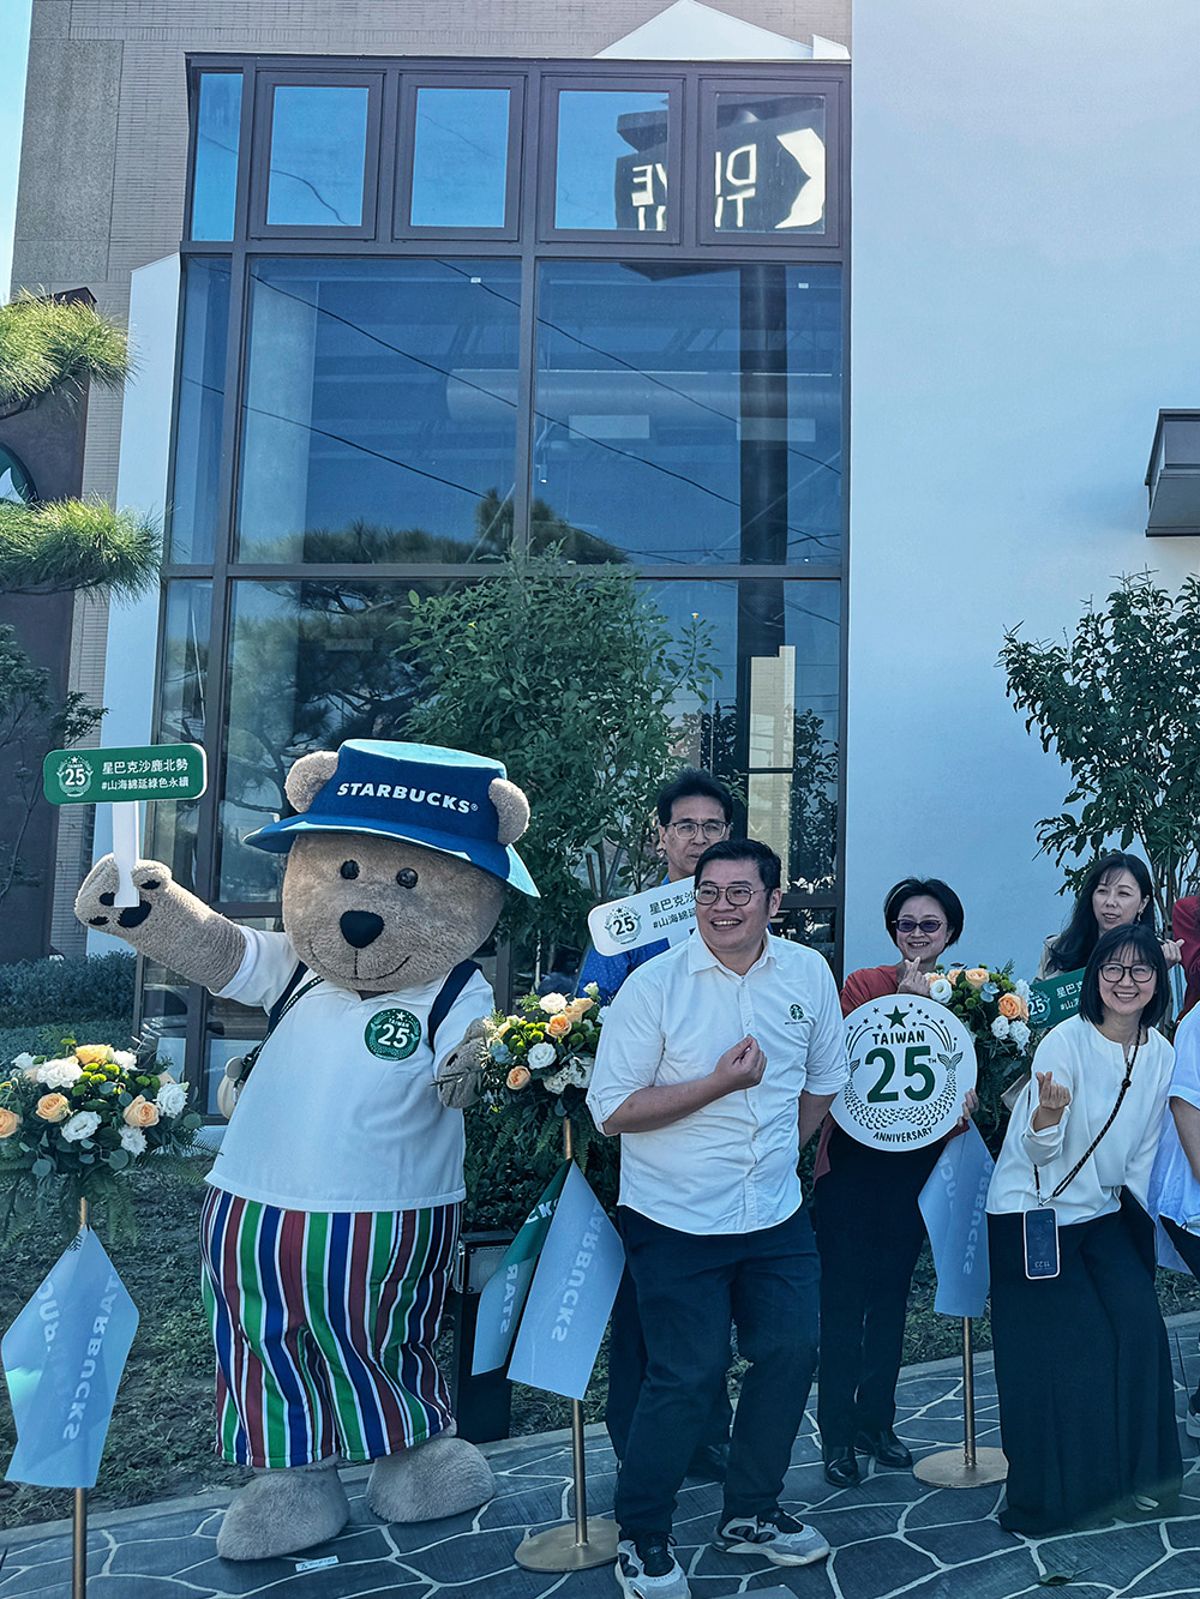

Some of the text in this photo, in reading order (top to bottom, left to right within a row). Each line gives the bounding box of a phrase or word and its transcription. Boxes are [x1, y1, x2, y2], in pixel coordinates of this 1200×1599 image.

[102, 758, 189, 775] 星巴克沙鹿北勢
[65, 768, 86, 786] 25
[613, 915, 635, 936] 25
[1027, 998, 1045, 1016] 25
[377, 1023, 410, 1048] 25
[872, 1030, 925, 1045] TAIWAN
[873, 1126, 933, 1142] ANNIVERSARY
